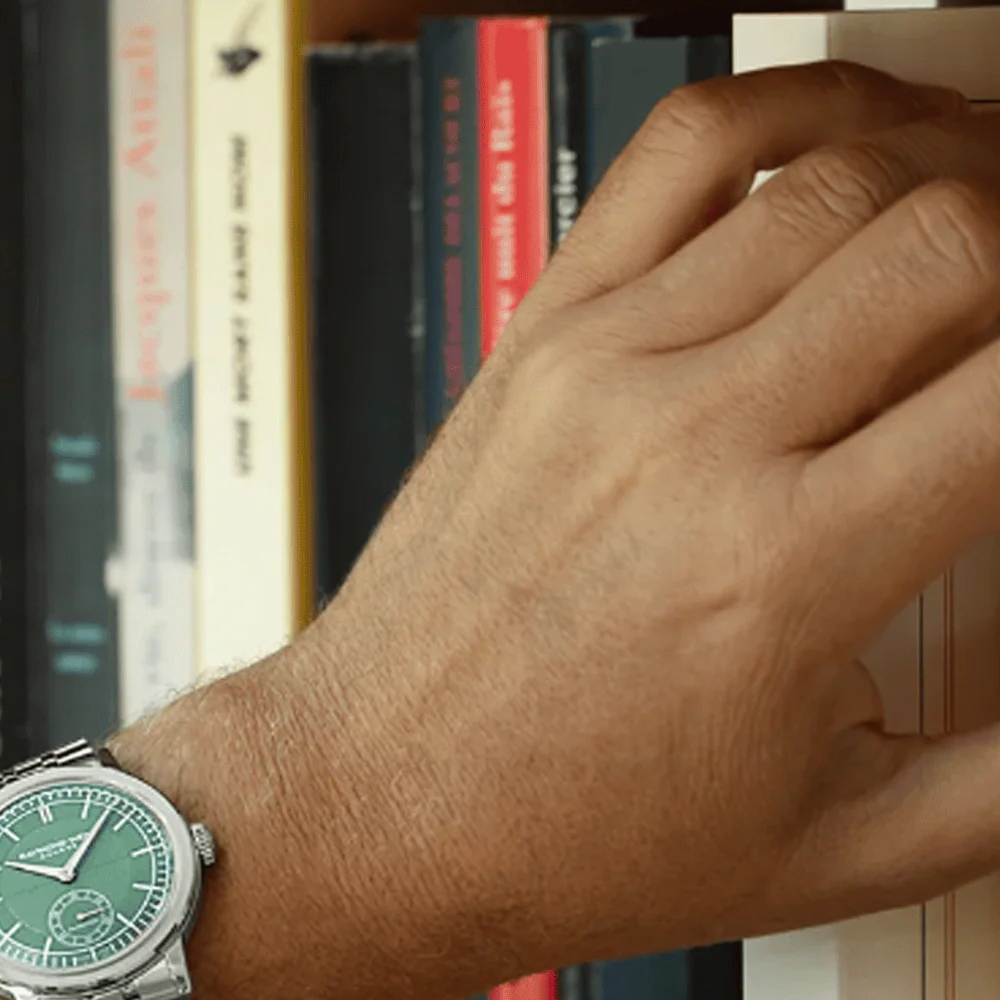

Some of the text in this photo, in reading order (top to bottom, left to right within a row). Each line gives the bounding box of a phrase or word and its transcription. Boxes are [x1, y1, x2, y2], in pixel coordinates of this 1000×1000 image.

[121, 25, 160, 178] Attali
[491, 161, 515, 205] du
[554, 146, 577, 246] rcier
[490, 213, 515, 280] nuit
[125, 195, 171, 399] Jacques
